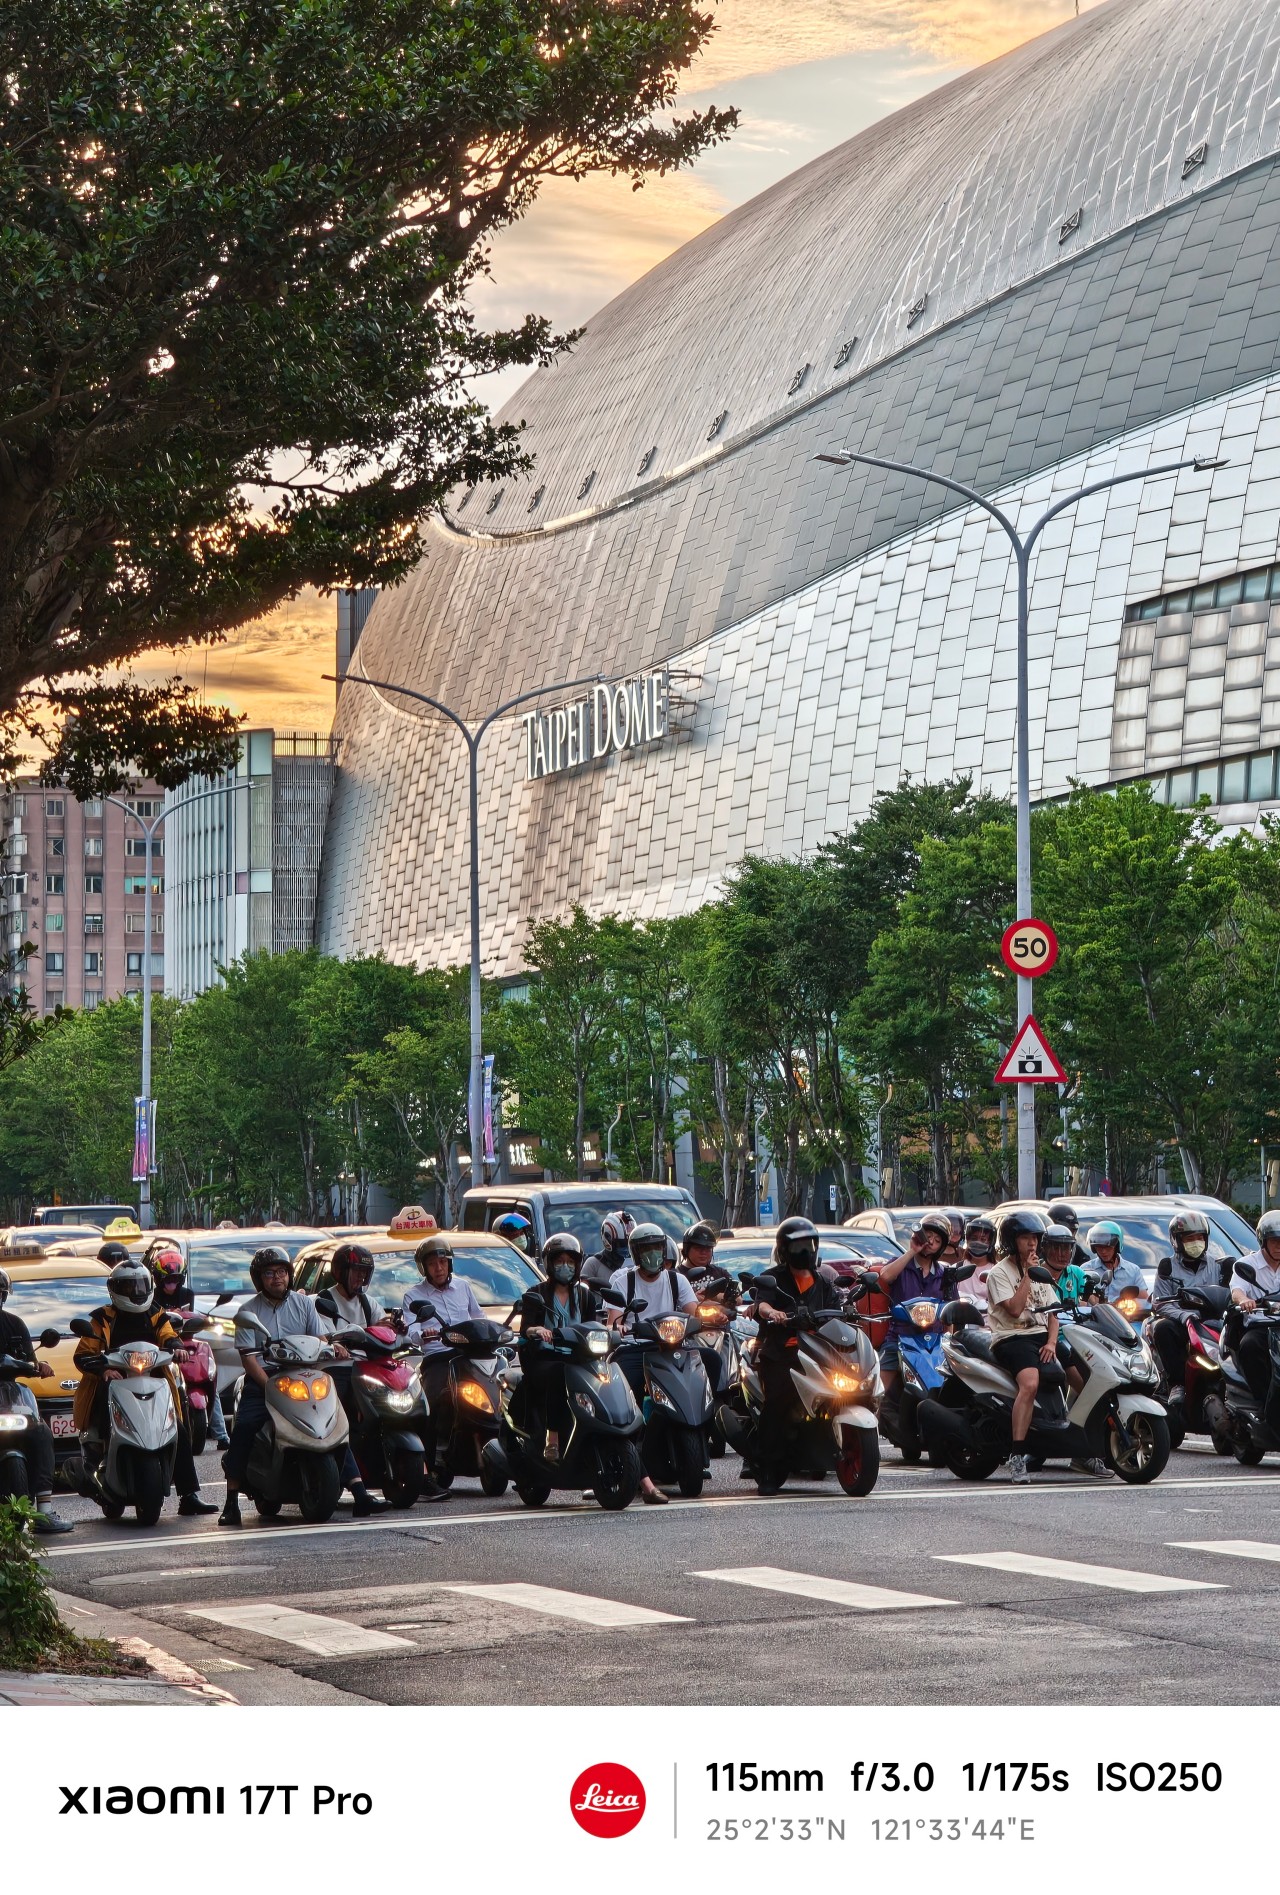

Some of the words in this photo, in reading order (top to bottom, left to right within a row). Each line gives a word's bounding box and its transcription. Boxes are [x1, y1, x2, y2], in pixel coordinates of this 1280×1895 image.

[522, 702, 588, 781] TAIPEI
[592, 672, 665, 759] DOME
[1014, 937, 1047, 958] 50
[395, 1219, 433, 1230] 台灣大車隊
[52, 1420, 77, 1435] 629
